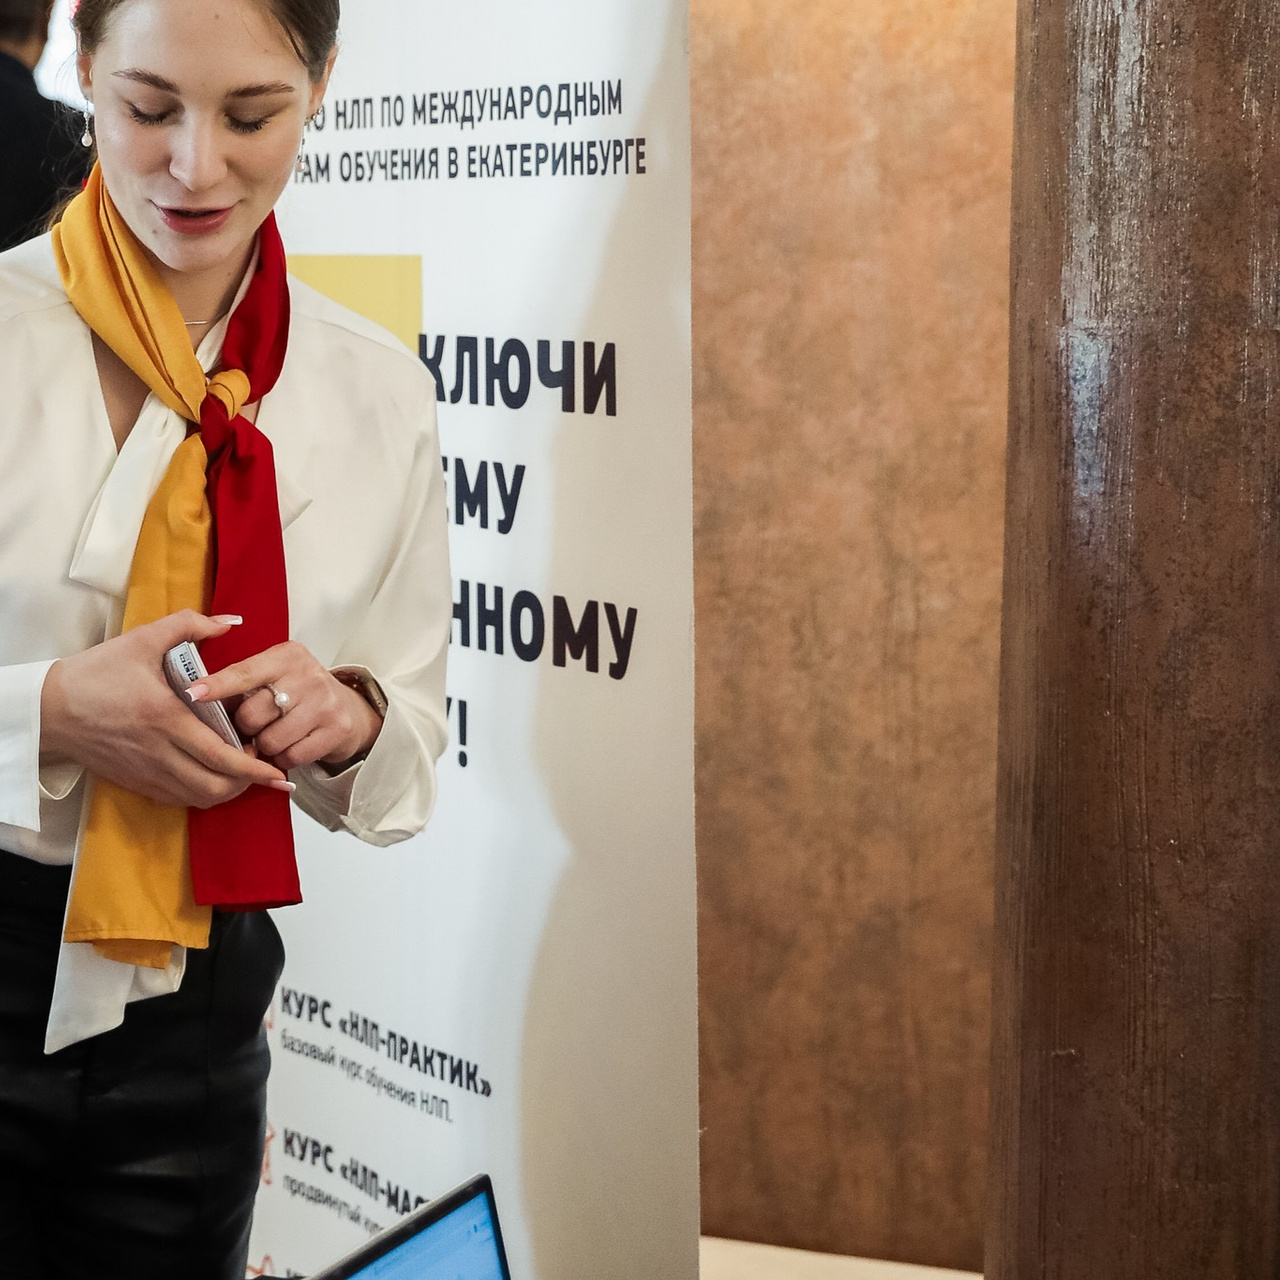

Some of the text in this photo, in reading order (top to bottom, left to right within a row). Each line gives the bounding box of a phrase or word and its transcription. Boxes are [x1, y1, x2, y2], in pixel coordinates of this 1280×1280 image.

[335, 98, 373, 130] НЛП
[380, 95, 405, 128] ПО
[412, 79, 622, 130] МЕЖДУНАРОДНЫМ
[340, 147, 439, 183] ОБУЧЕНИЯ
[448, 147, 459, 179] В
[468, 137, 646, 180] ЕКАТЕРИНБУРГЕ
[419, 333, 617, 417] КЛЮЧИ
[441, 456, 525, 534] МУ
[281, 986, 492, 1097] КУРС «НЛП-ПРАКТИК»
[283, 1127, 430, 1216] КУРС «НЛП-МА
